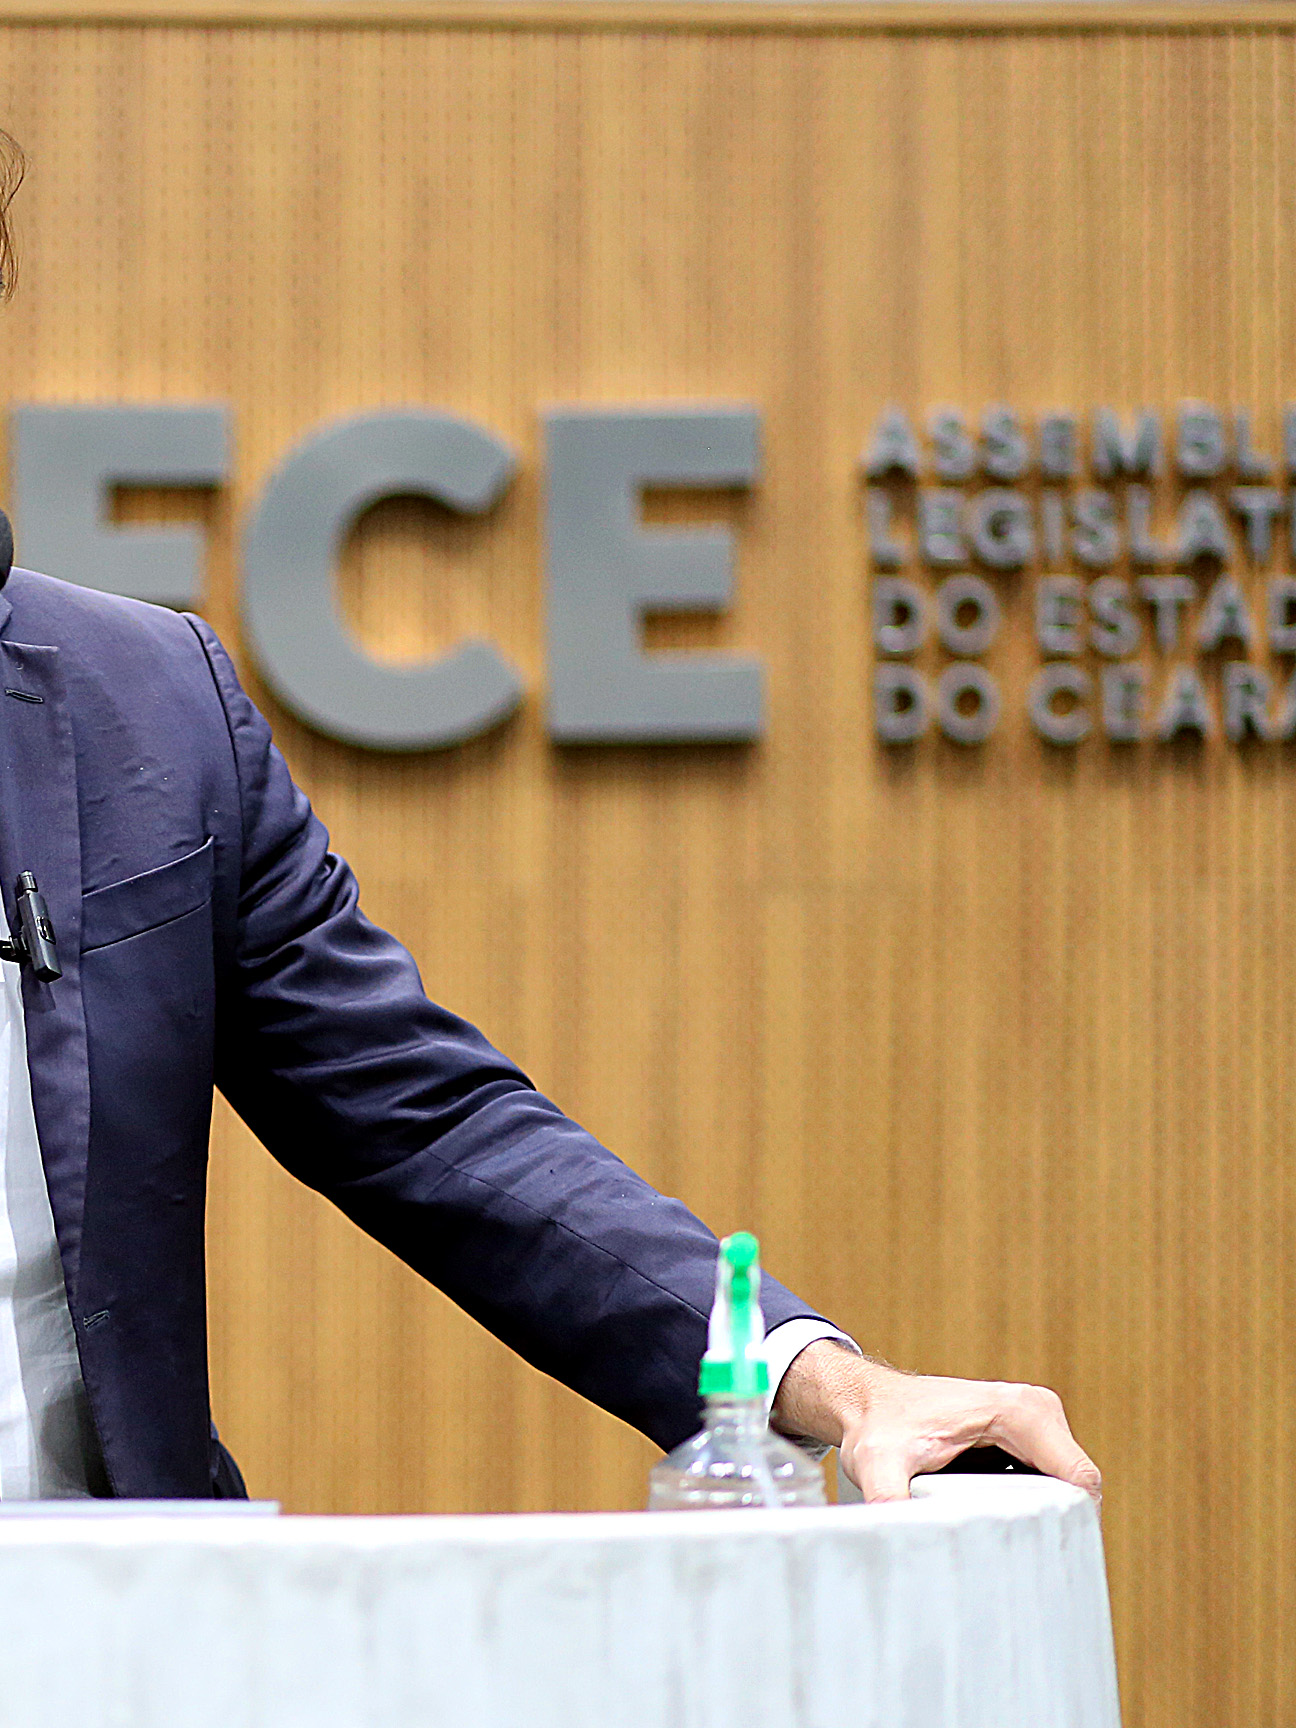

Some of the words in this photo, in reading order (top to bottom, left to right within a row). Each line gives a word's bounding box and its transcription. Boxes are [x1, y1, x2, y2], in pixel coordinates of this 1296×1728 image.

[864, 402, 1296, 476] ASSEMBL
[867, 487, 1296, 565] LEGISLAT
[872, 573, 1001, 655] DO
[872, 662, 1001, 742] DO
